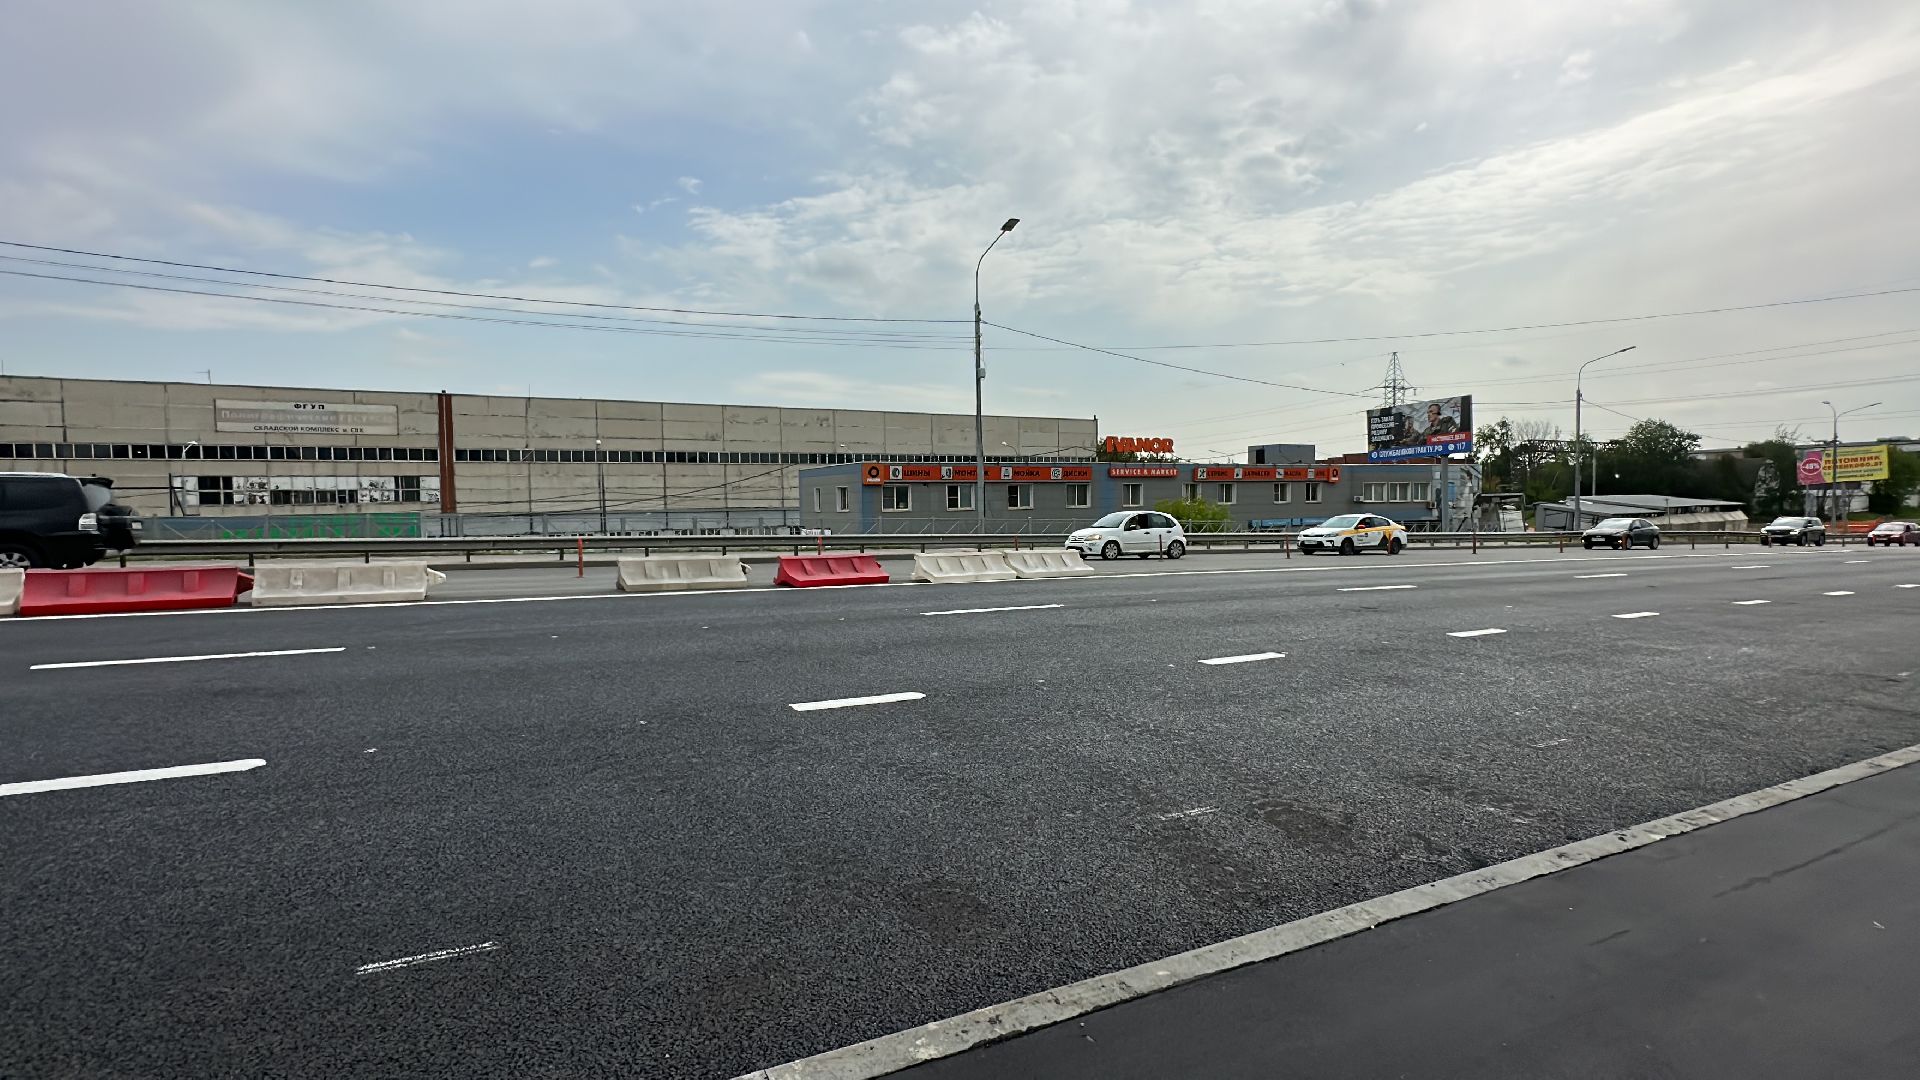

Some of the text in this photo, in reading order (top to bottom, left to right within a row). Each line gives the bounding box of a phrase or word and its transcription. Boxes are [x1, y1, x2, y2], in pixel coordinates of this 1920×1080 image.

[1106, 436, 1174, 453] IVANOR
[1456, 442, 1466, 450] 117
[1824, 455, 1881, 465] ПТОМНИК
[903, 469, 931, 477] ШИНЫ
[1013, 469, 1041, 477] МОЙКА
[1062, 470, 1088, 478] ДИСКИ
[1111, 468, 1141, 476] SERVICE
[1150, 468, 1178, 476] MARKET
